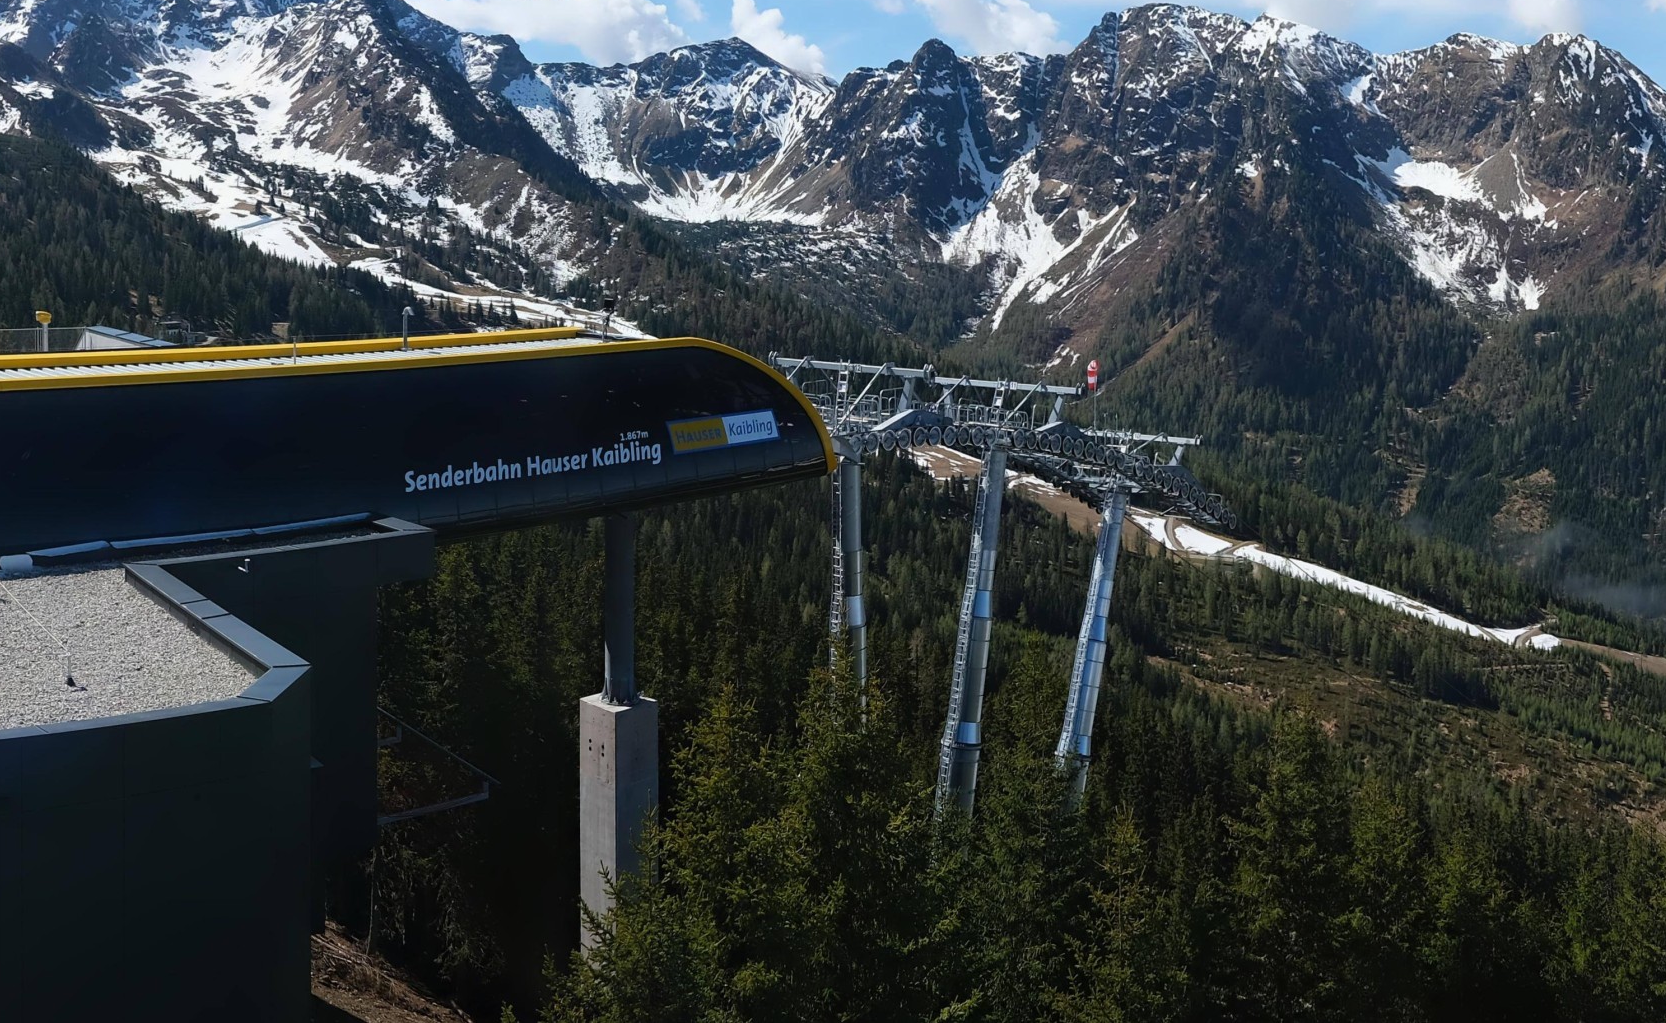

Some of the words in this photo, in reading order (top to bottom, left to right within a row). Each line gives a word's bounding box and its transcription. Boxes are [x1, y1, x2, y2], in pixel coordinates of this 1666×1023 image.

[619, 430, 649, 442] 1.867m
[675, 427, 723, 444] HAUSER
[728, 419, 773, 437] Kaibling
[404, 458, 522, 493] Senderbahn
[526, 453, 588, 477] Hauser
[592, 440, 662, 468] Kaibling
